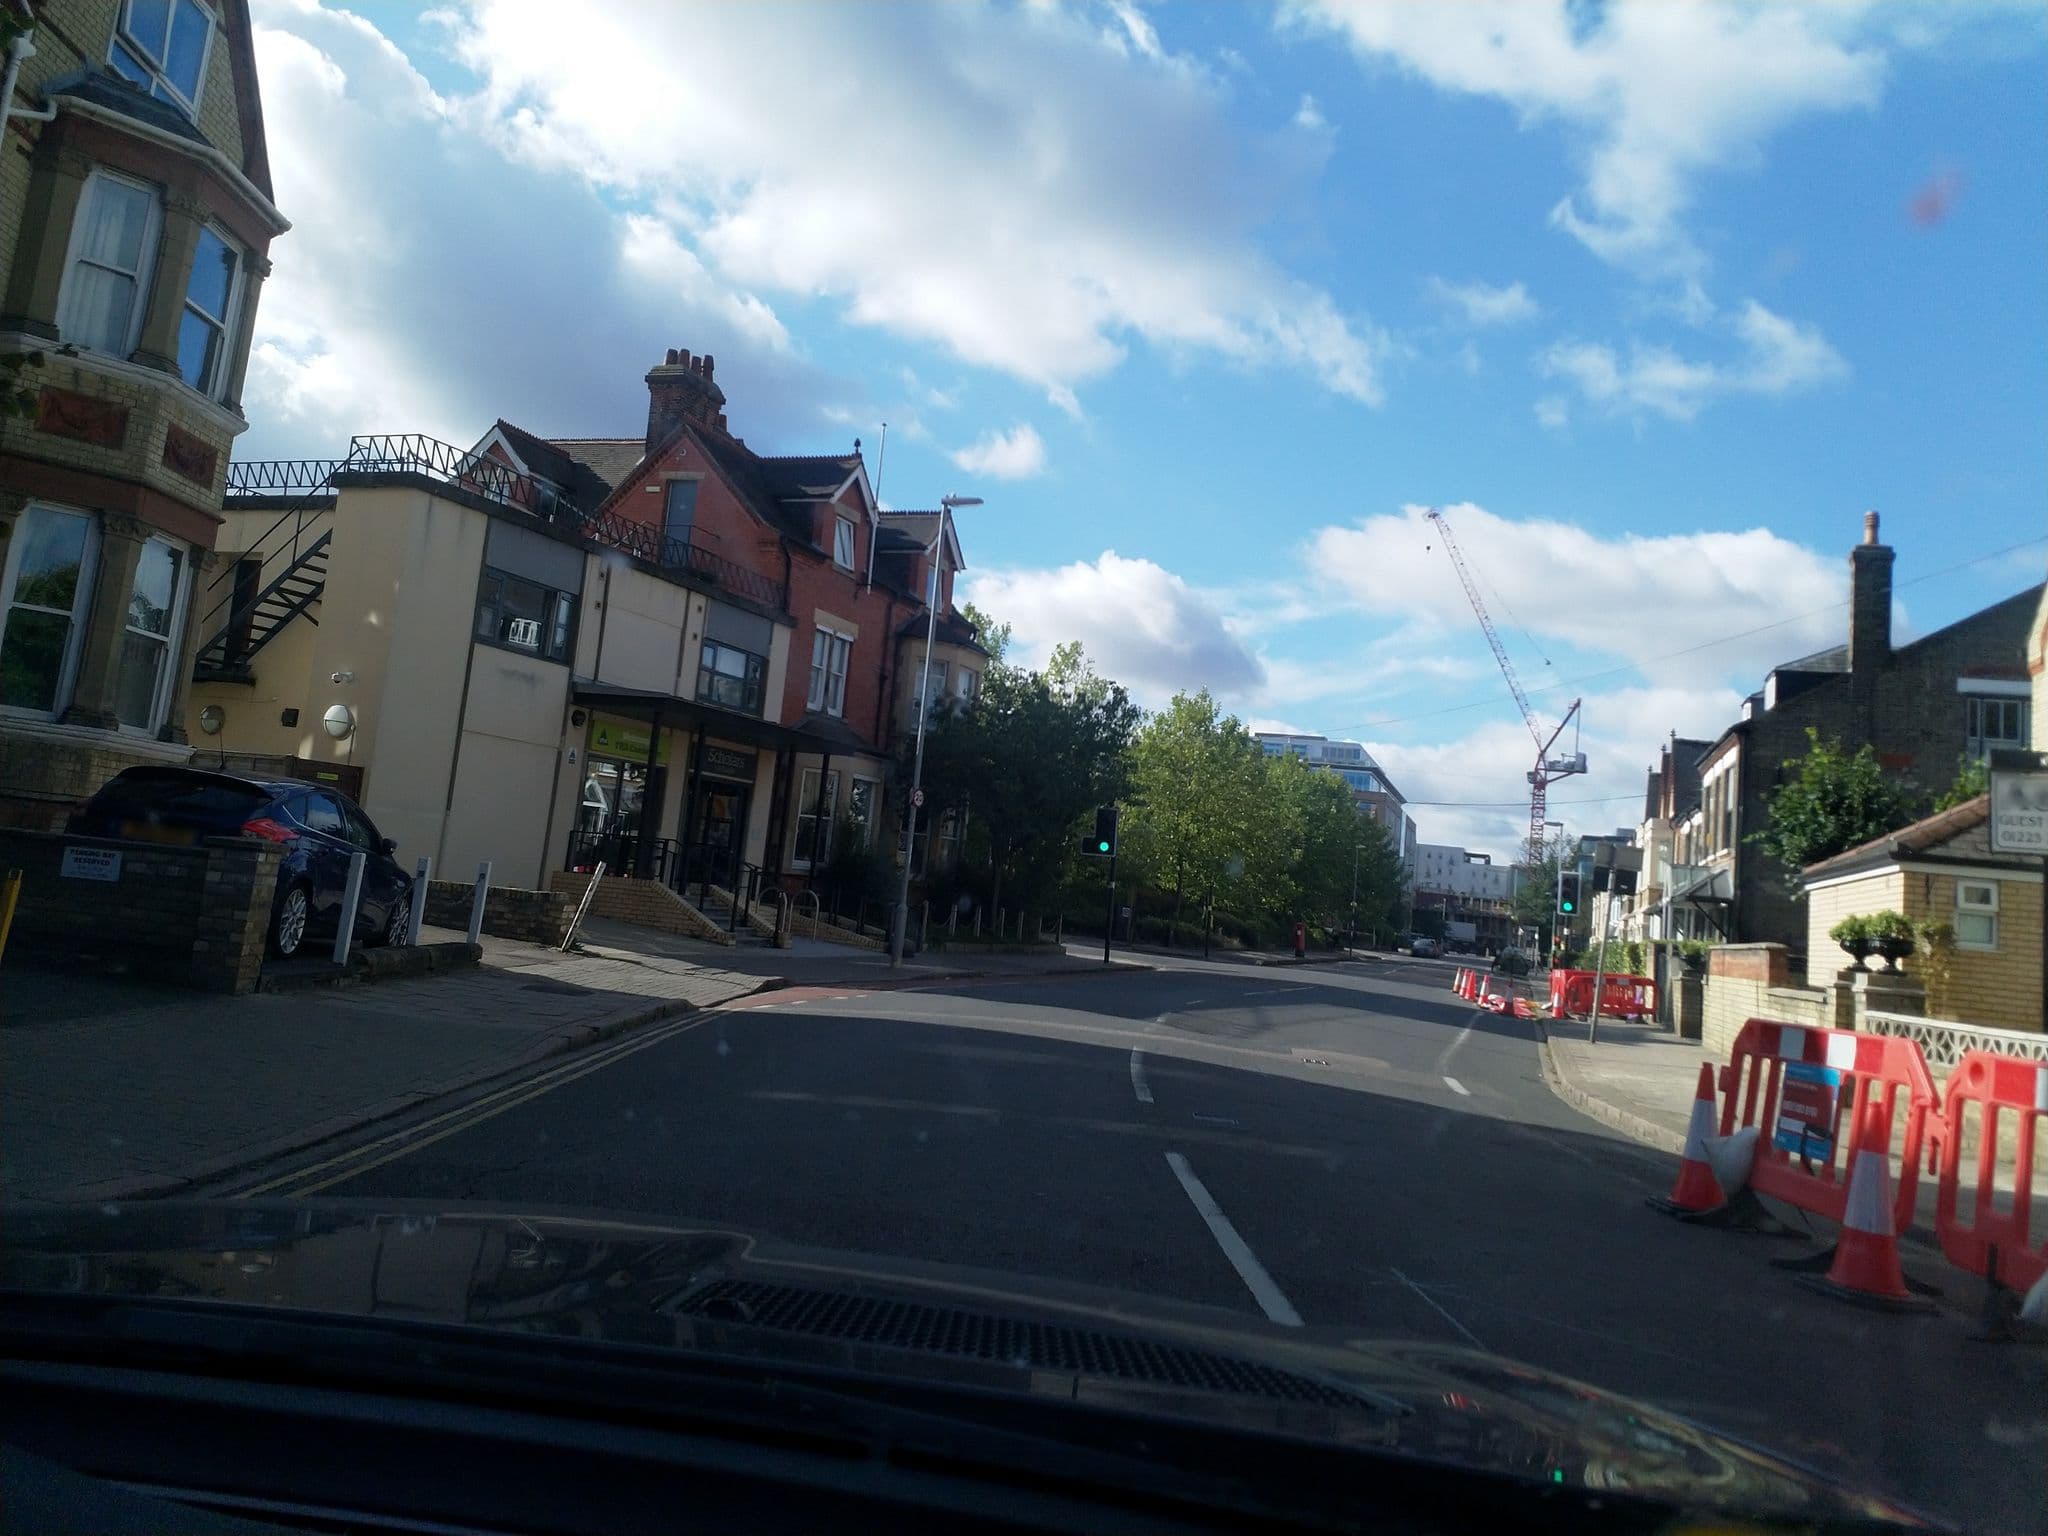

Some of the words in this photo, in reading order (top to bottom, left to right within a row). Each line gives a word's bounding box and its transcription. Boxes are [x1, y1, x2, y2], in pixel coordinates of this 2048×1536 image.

[915, 793, 923, 802] 20
[2000, 814, 2042, 827] GUEST
[2000, 831, 2042, 843] 01223
